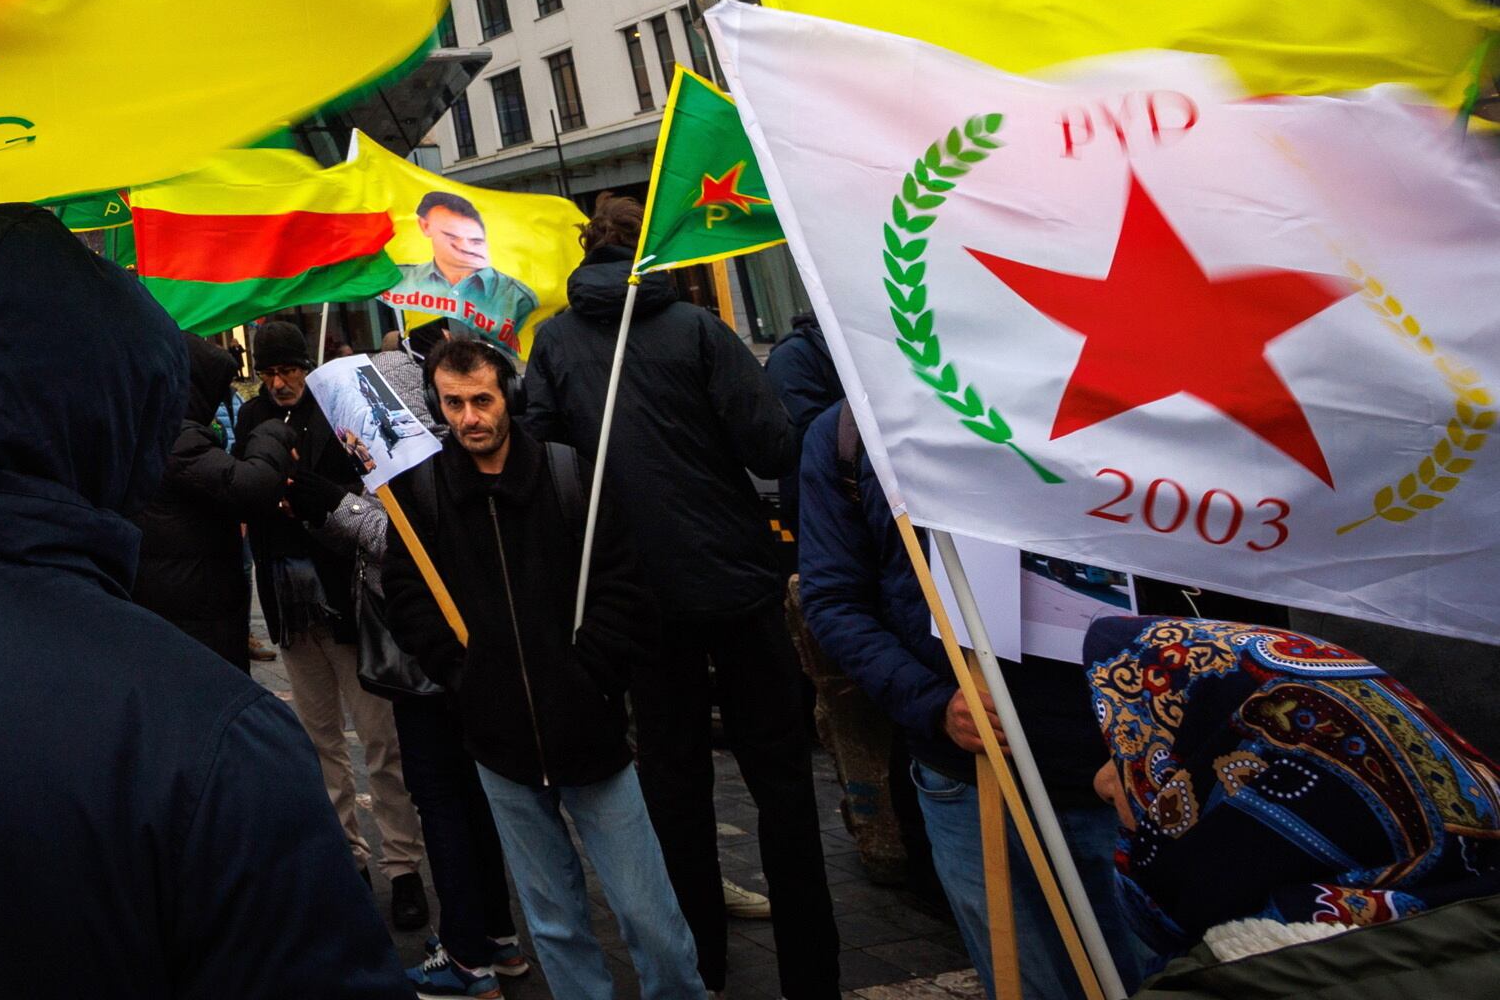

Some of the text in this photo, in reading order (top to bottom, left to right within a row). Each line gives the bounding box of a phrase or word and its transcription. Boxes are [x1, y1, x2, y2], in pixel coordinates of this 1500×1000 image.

[1055, 90, 1200, 160] PYD
[706, 204, 731, 229] P
[463, 301, 496, 333] For
[1084, 467, 1291, 552] 2003
